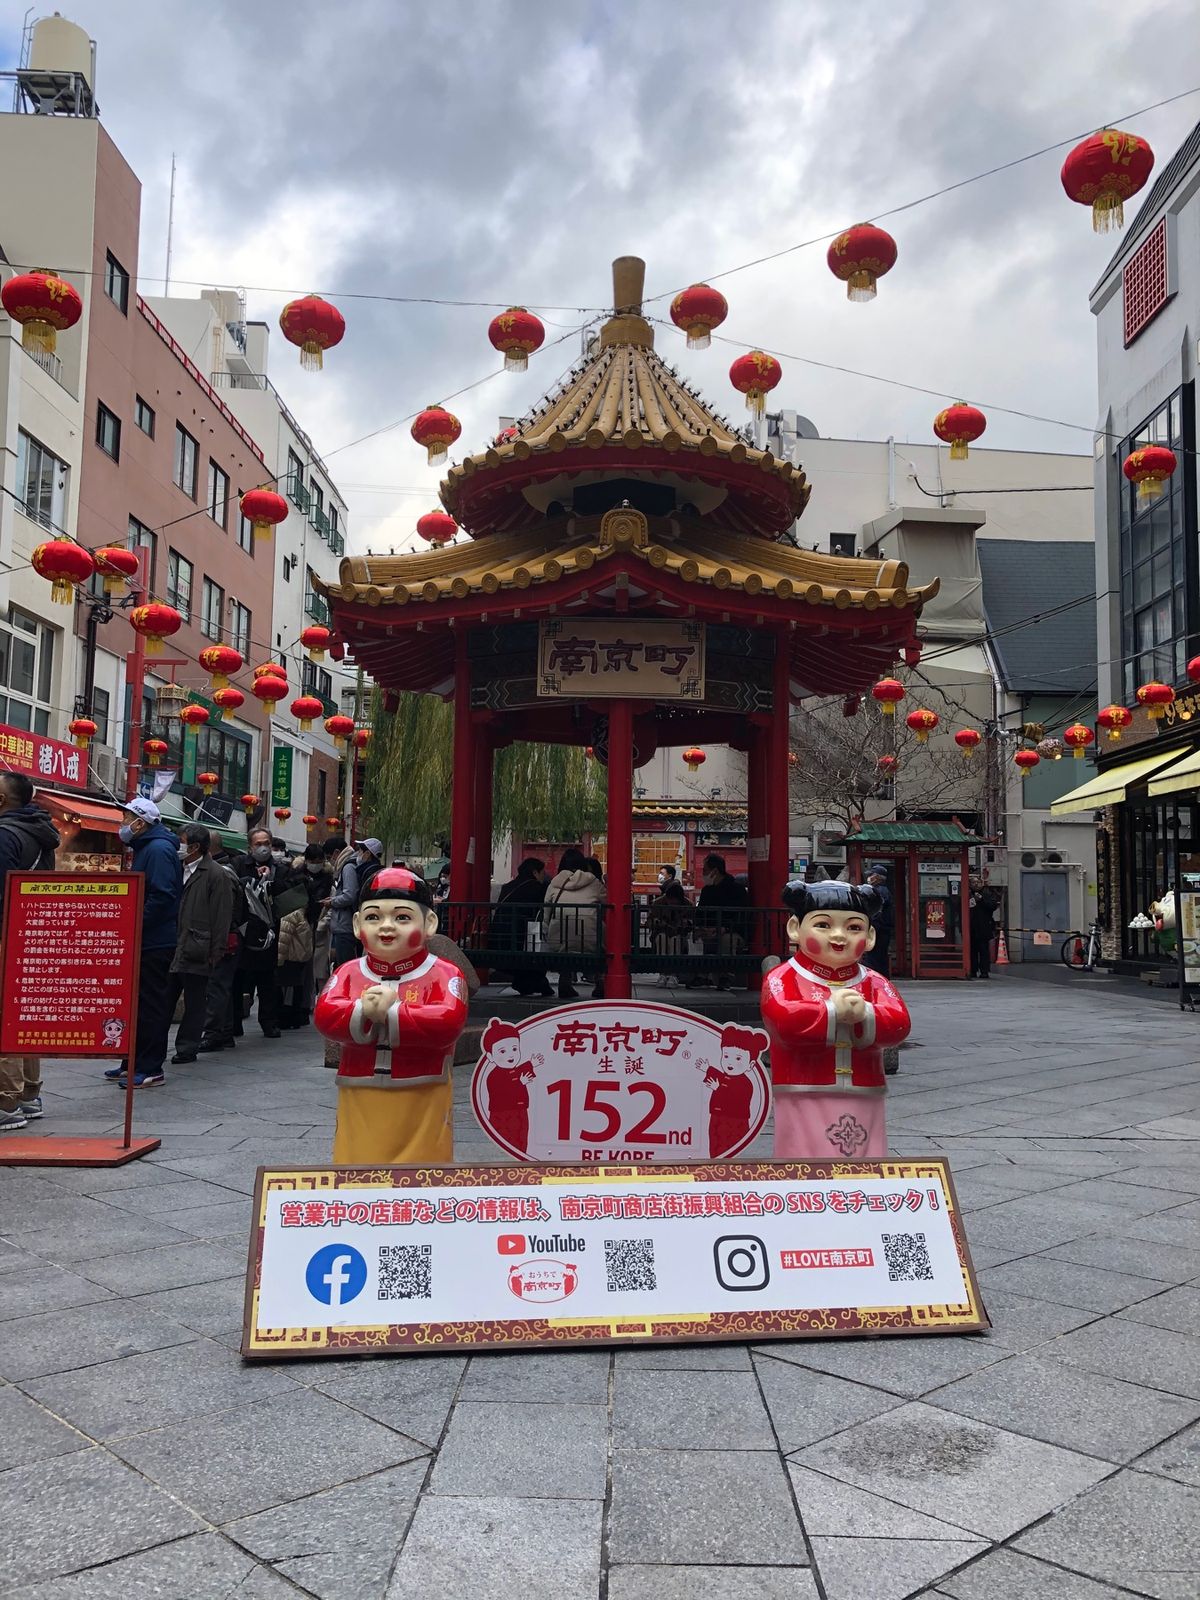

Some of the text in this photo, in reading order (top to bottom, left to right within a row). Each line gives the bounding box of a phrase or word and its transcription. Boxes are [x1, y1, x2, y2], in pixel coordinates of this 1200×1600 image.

[549, 637, 696, 676] 南京町
[0, 733, 34, 759] 中華料理
[30, 884, 119, 894] 南京町内禁止事項
[553, 1020, 688, 1057] 南京町
[597, 1056, 645, 1075] 生誕
[547, 1079, 692, 1146] 152nd
[528, 1233, 586, 1253] YouTube
[784, 1251, 872, 1268] #LOVE南京町
[523, 1281, 561, 1292] 南京町
